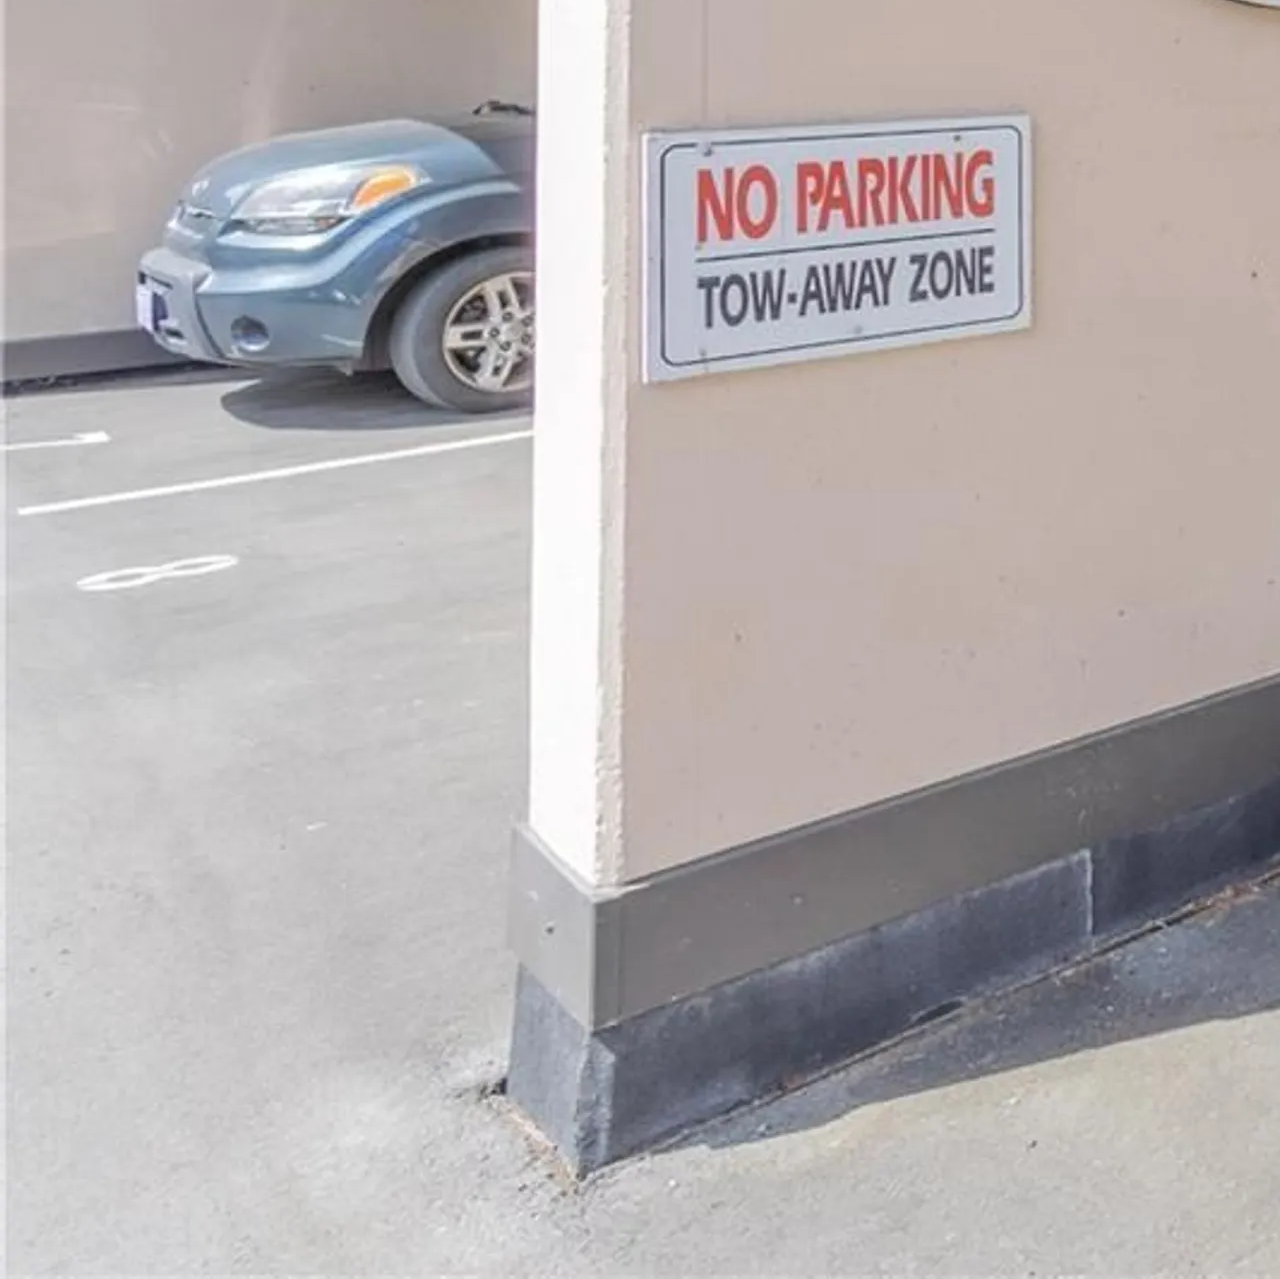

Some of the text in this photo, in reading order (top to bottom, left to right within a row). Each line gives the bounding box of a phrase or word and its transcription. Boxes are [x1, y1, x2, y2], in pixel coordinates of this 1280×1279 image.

[697, 149, 995, 243] NO PARKING
[697, 246, 995, 329] TOW-AWAY ZONE
